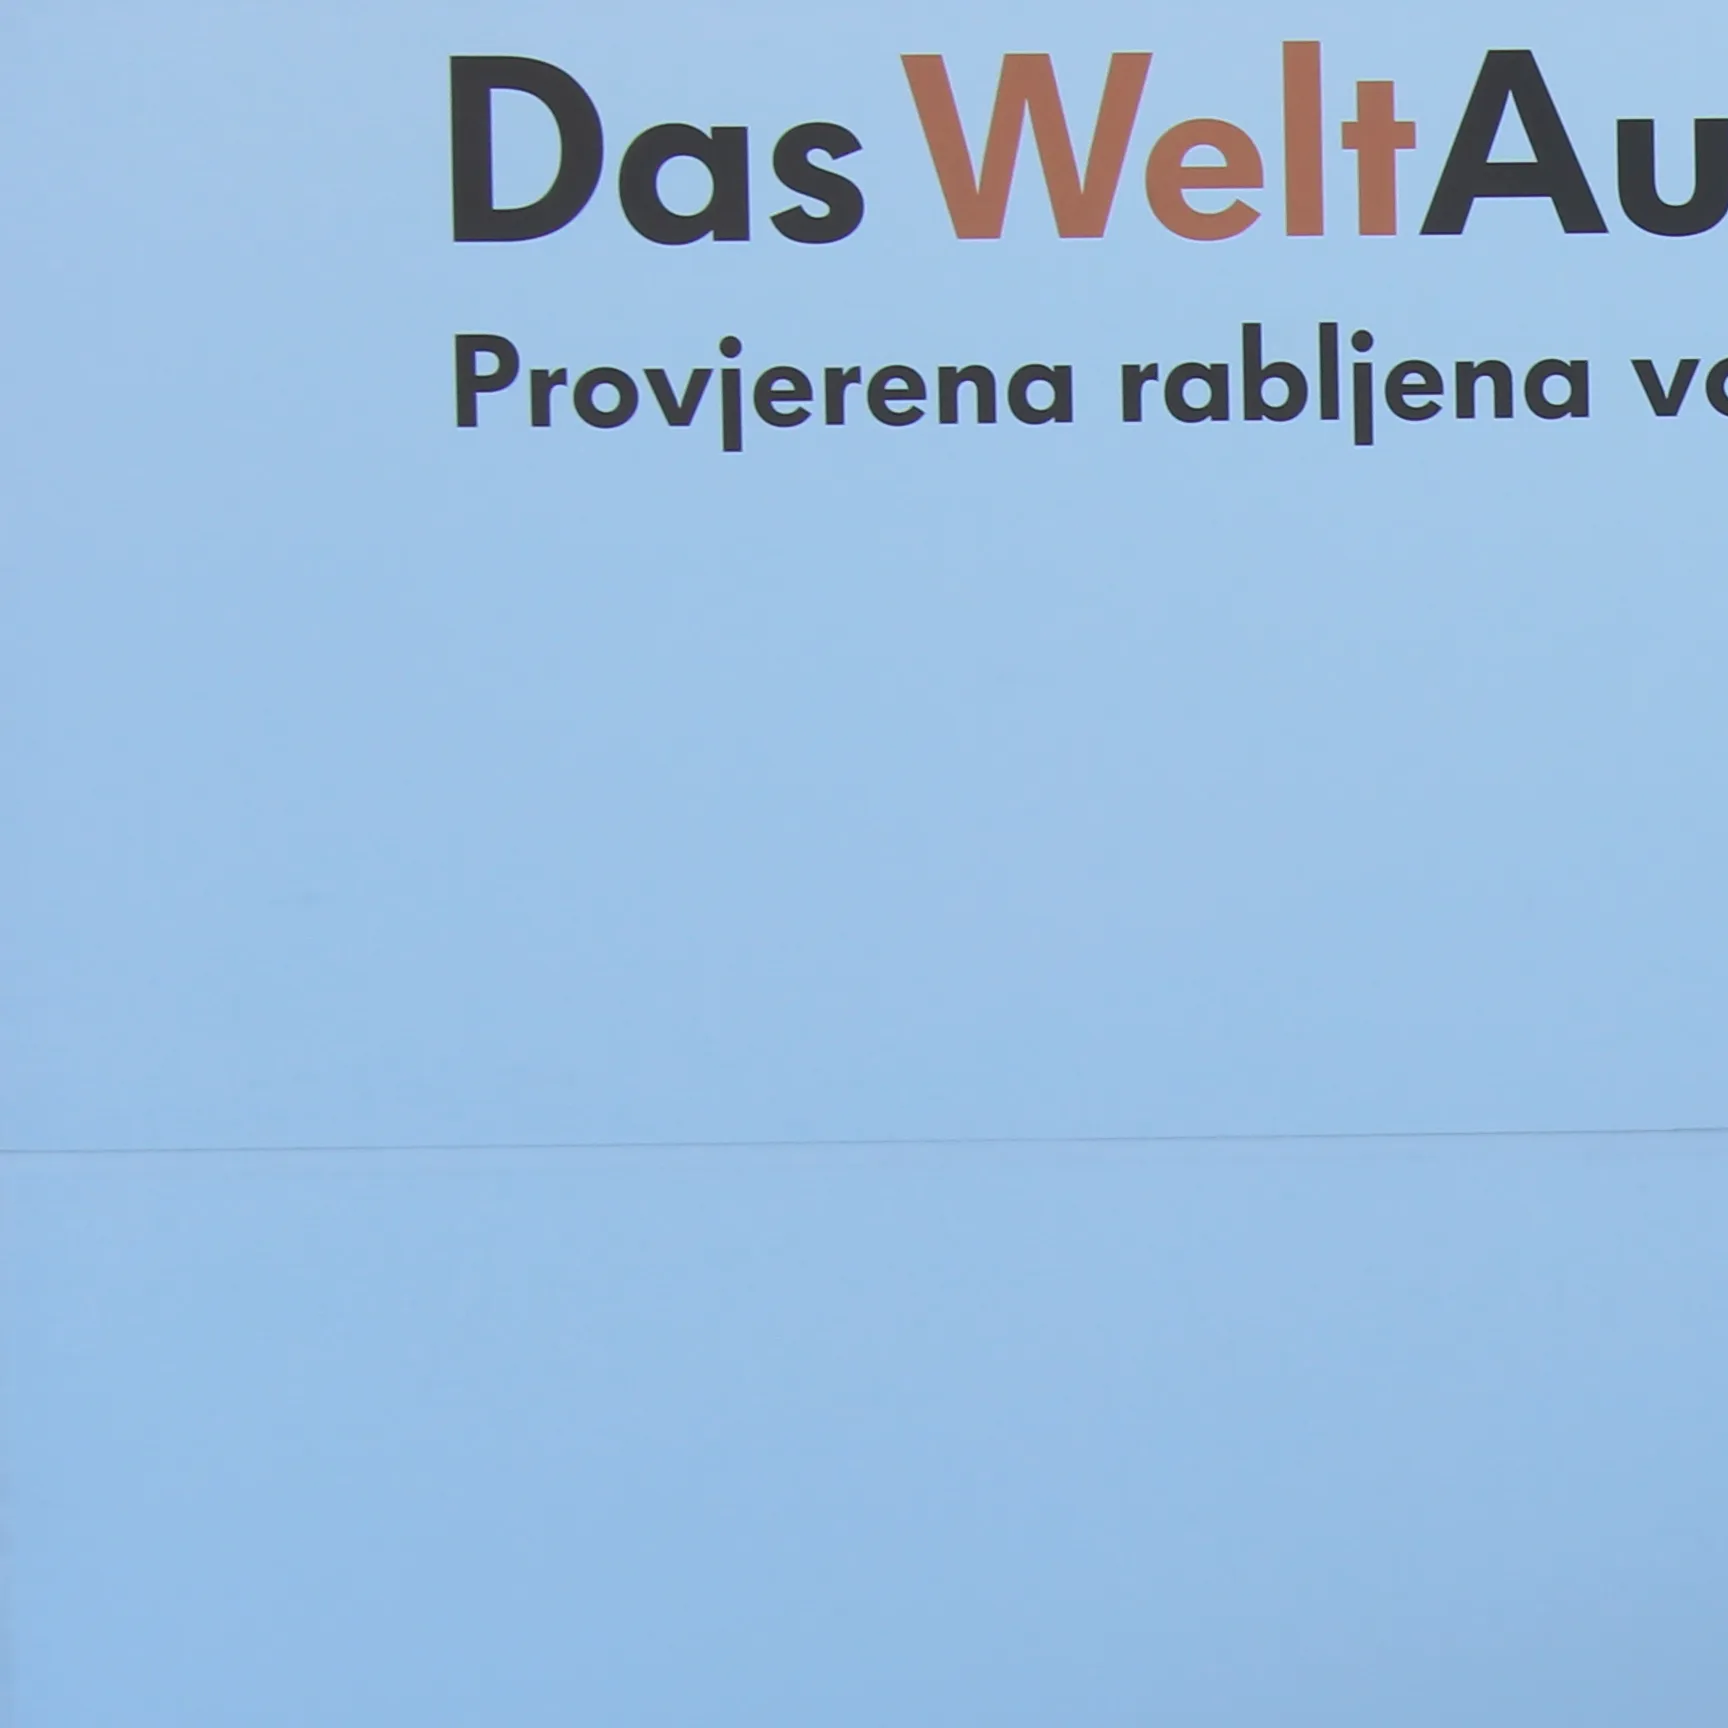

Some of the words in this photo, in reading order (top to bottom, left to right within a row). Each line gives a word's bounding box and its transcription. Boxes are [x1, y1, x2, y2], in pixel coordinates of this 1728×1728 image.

[450, 56, 864, 245] Das
[454, 333, 1074, 452] Provjerena
[1121, 322, 1590, 447] rabljena
